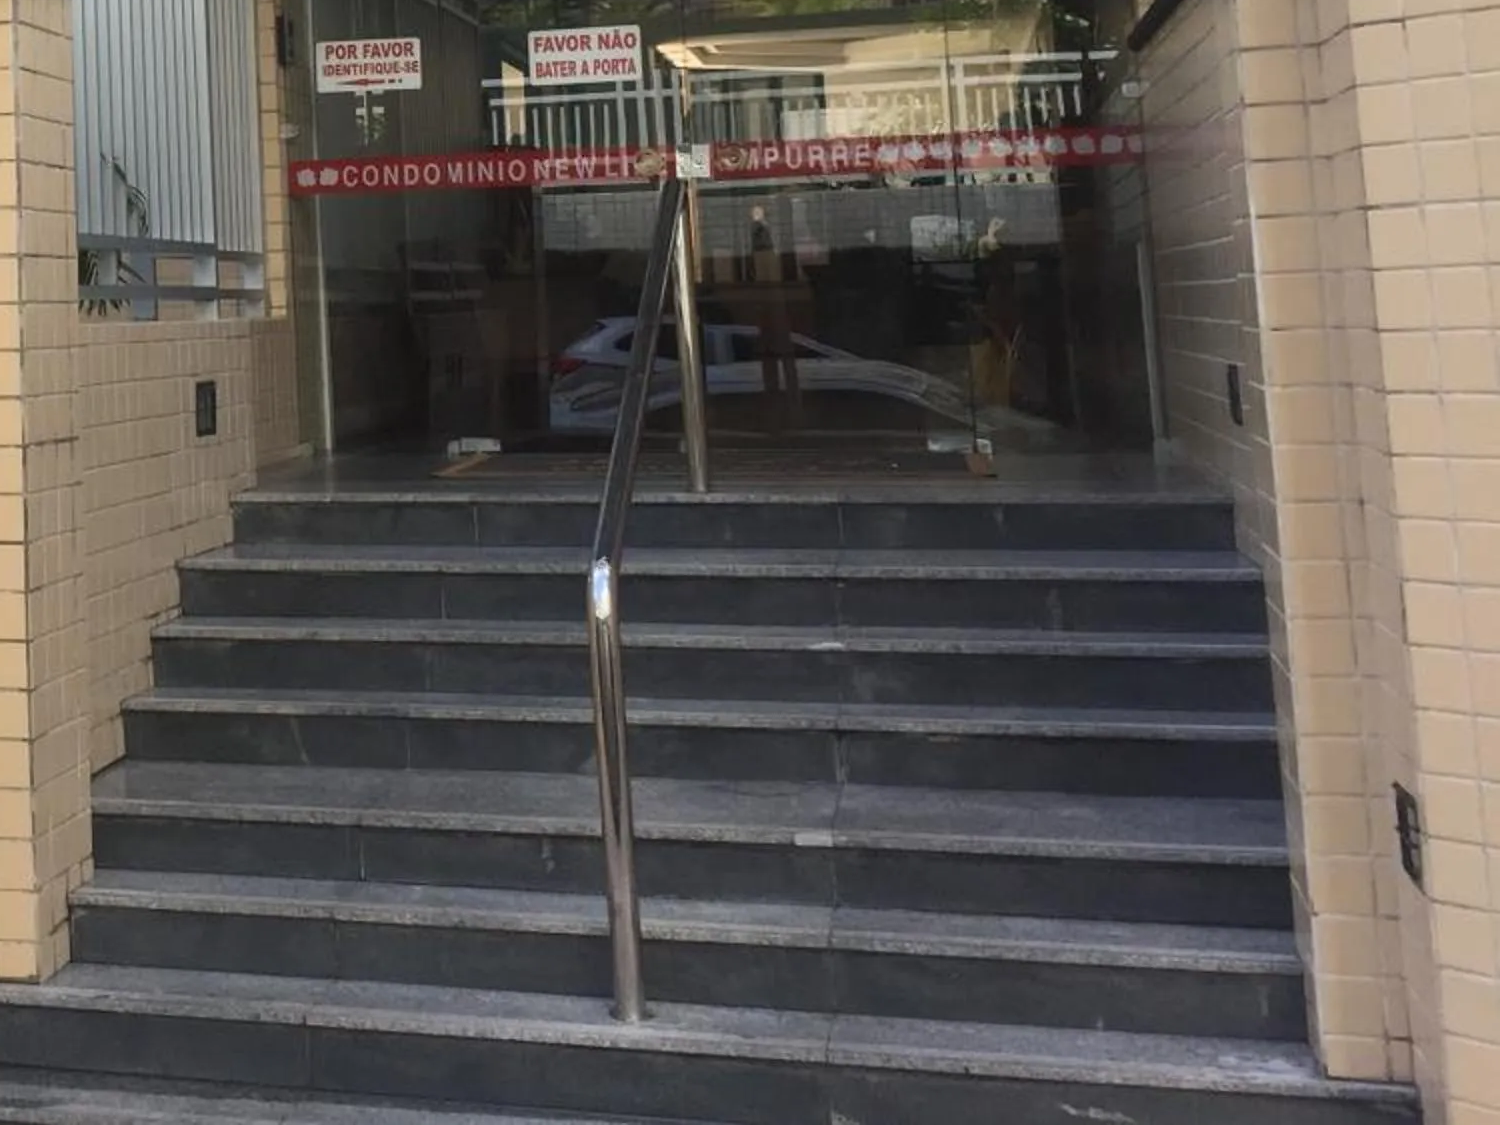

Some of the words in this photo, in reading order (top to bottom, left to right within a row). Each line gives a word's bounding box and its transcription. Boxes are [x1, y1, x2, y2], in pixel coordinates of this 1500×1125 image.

[325, 44, 357, 61] POR
[363, 42, 414, 59] FAVOR
[533, 34, 592, 53] FAVOR
[597, 29, 638, 51] NÃO
[323, 60, 419, 77] IDENTIFIQUE-SE
[535, 60, 577, 78] BATER
[580, 59, 590, 76] A
[593, 57, 637, 75] PORTA
[718, 142, 871, 173] MPURRE
[342, 158, 526, 188] CONDOMINIO
[533, 154, 597, 180] NEW
